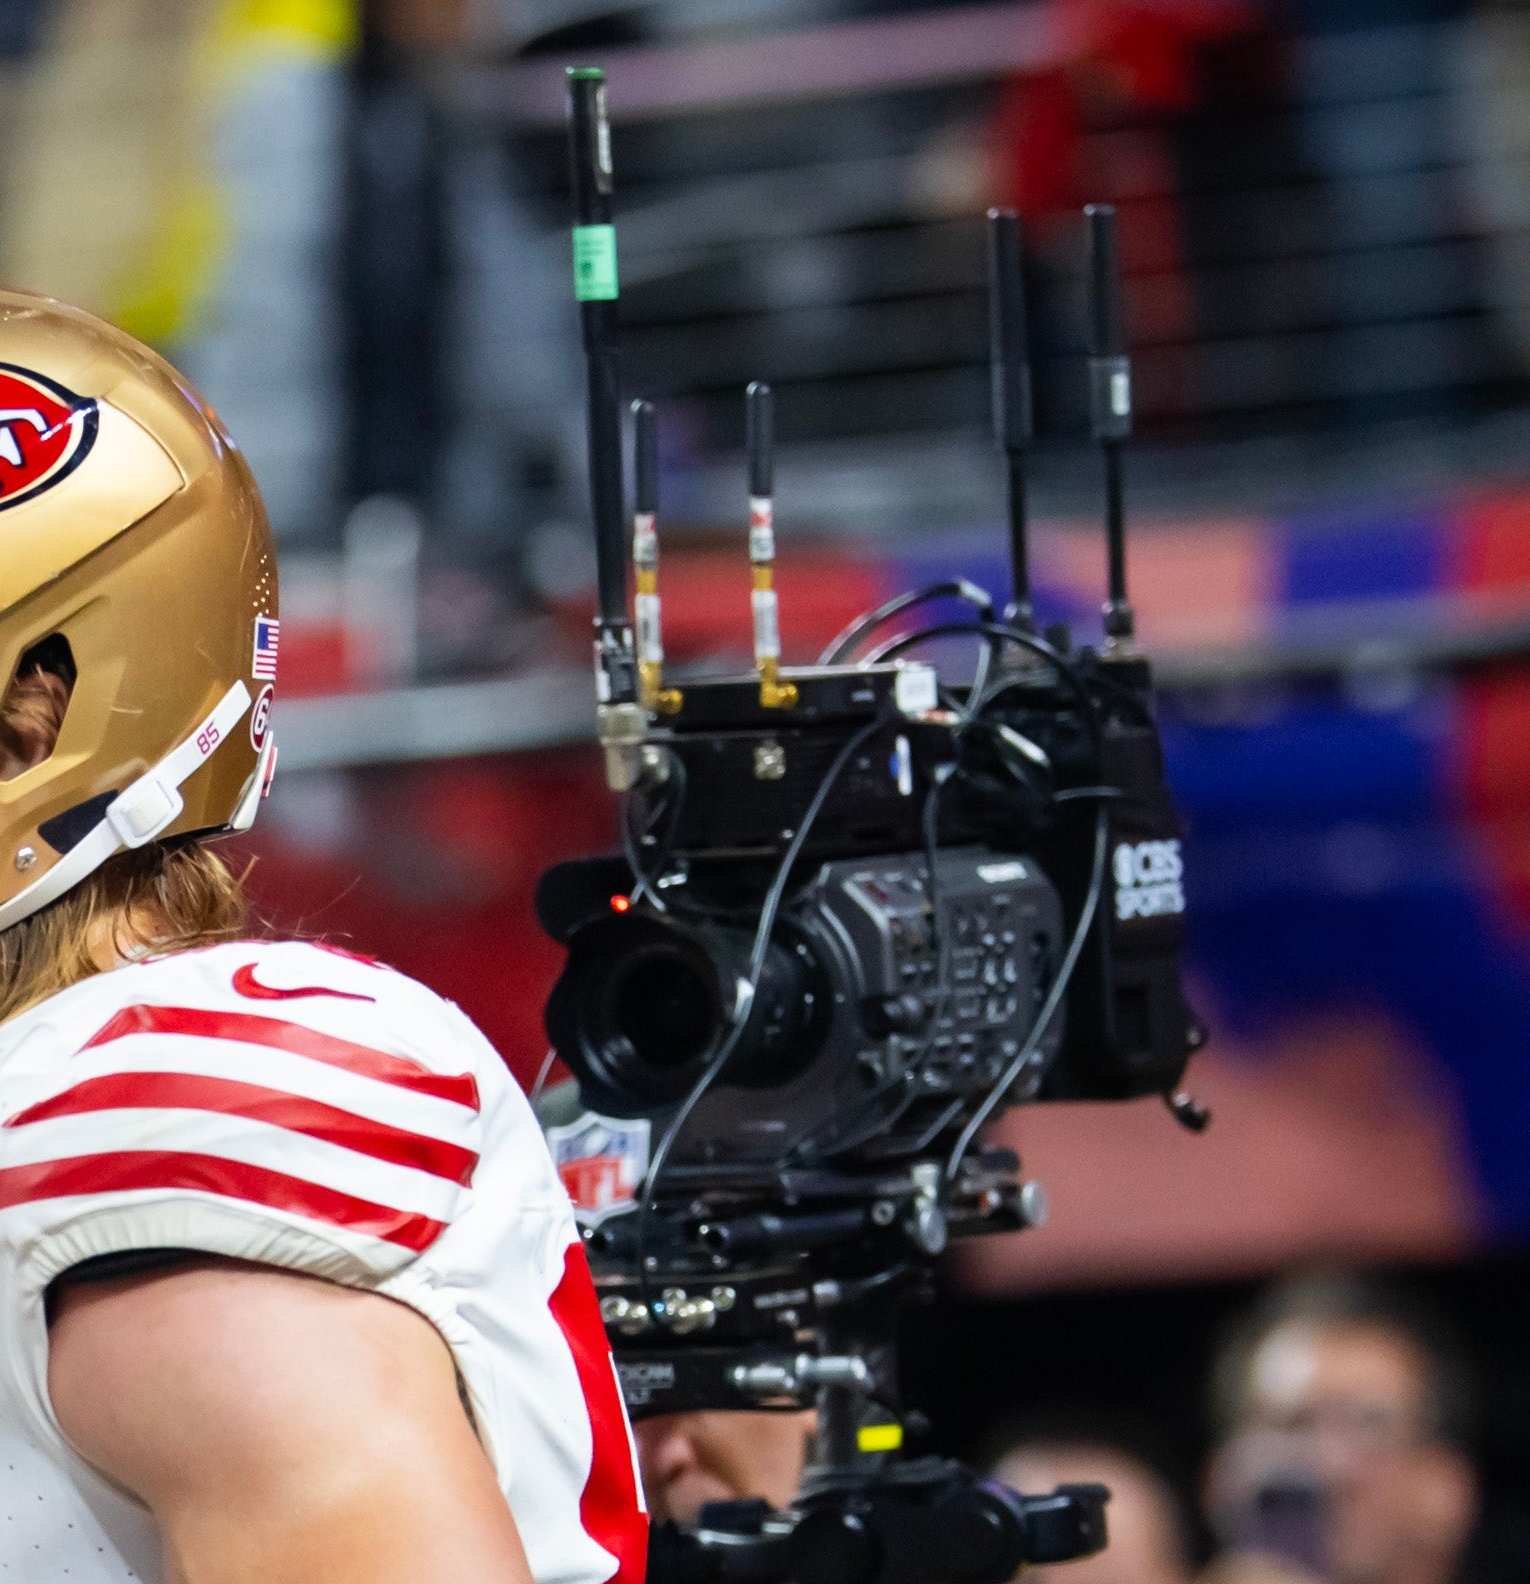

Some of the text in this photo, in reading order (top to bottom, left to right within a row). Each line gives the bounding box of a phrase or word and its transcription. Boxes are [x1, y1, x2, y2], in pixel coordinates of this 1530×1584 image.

[196, 721, 220, 755] 85
[1135, 839, 1183, 885] CBS
[1115, 884, 1186, 920] SPORTS
[557, 1154, 636, 1211] NFL
